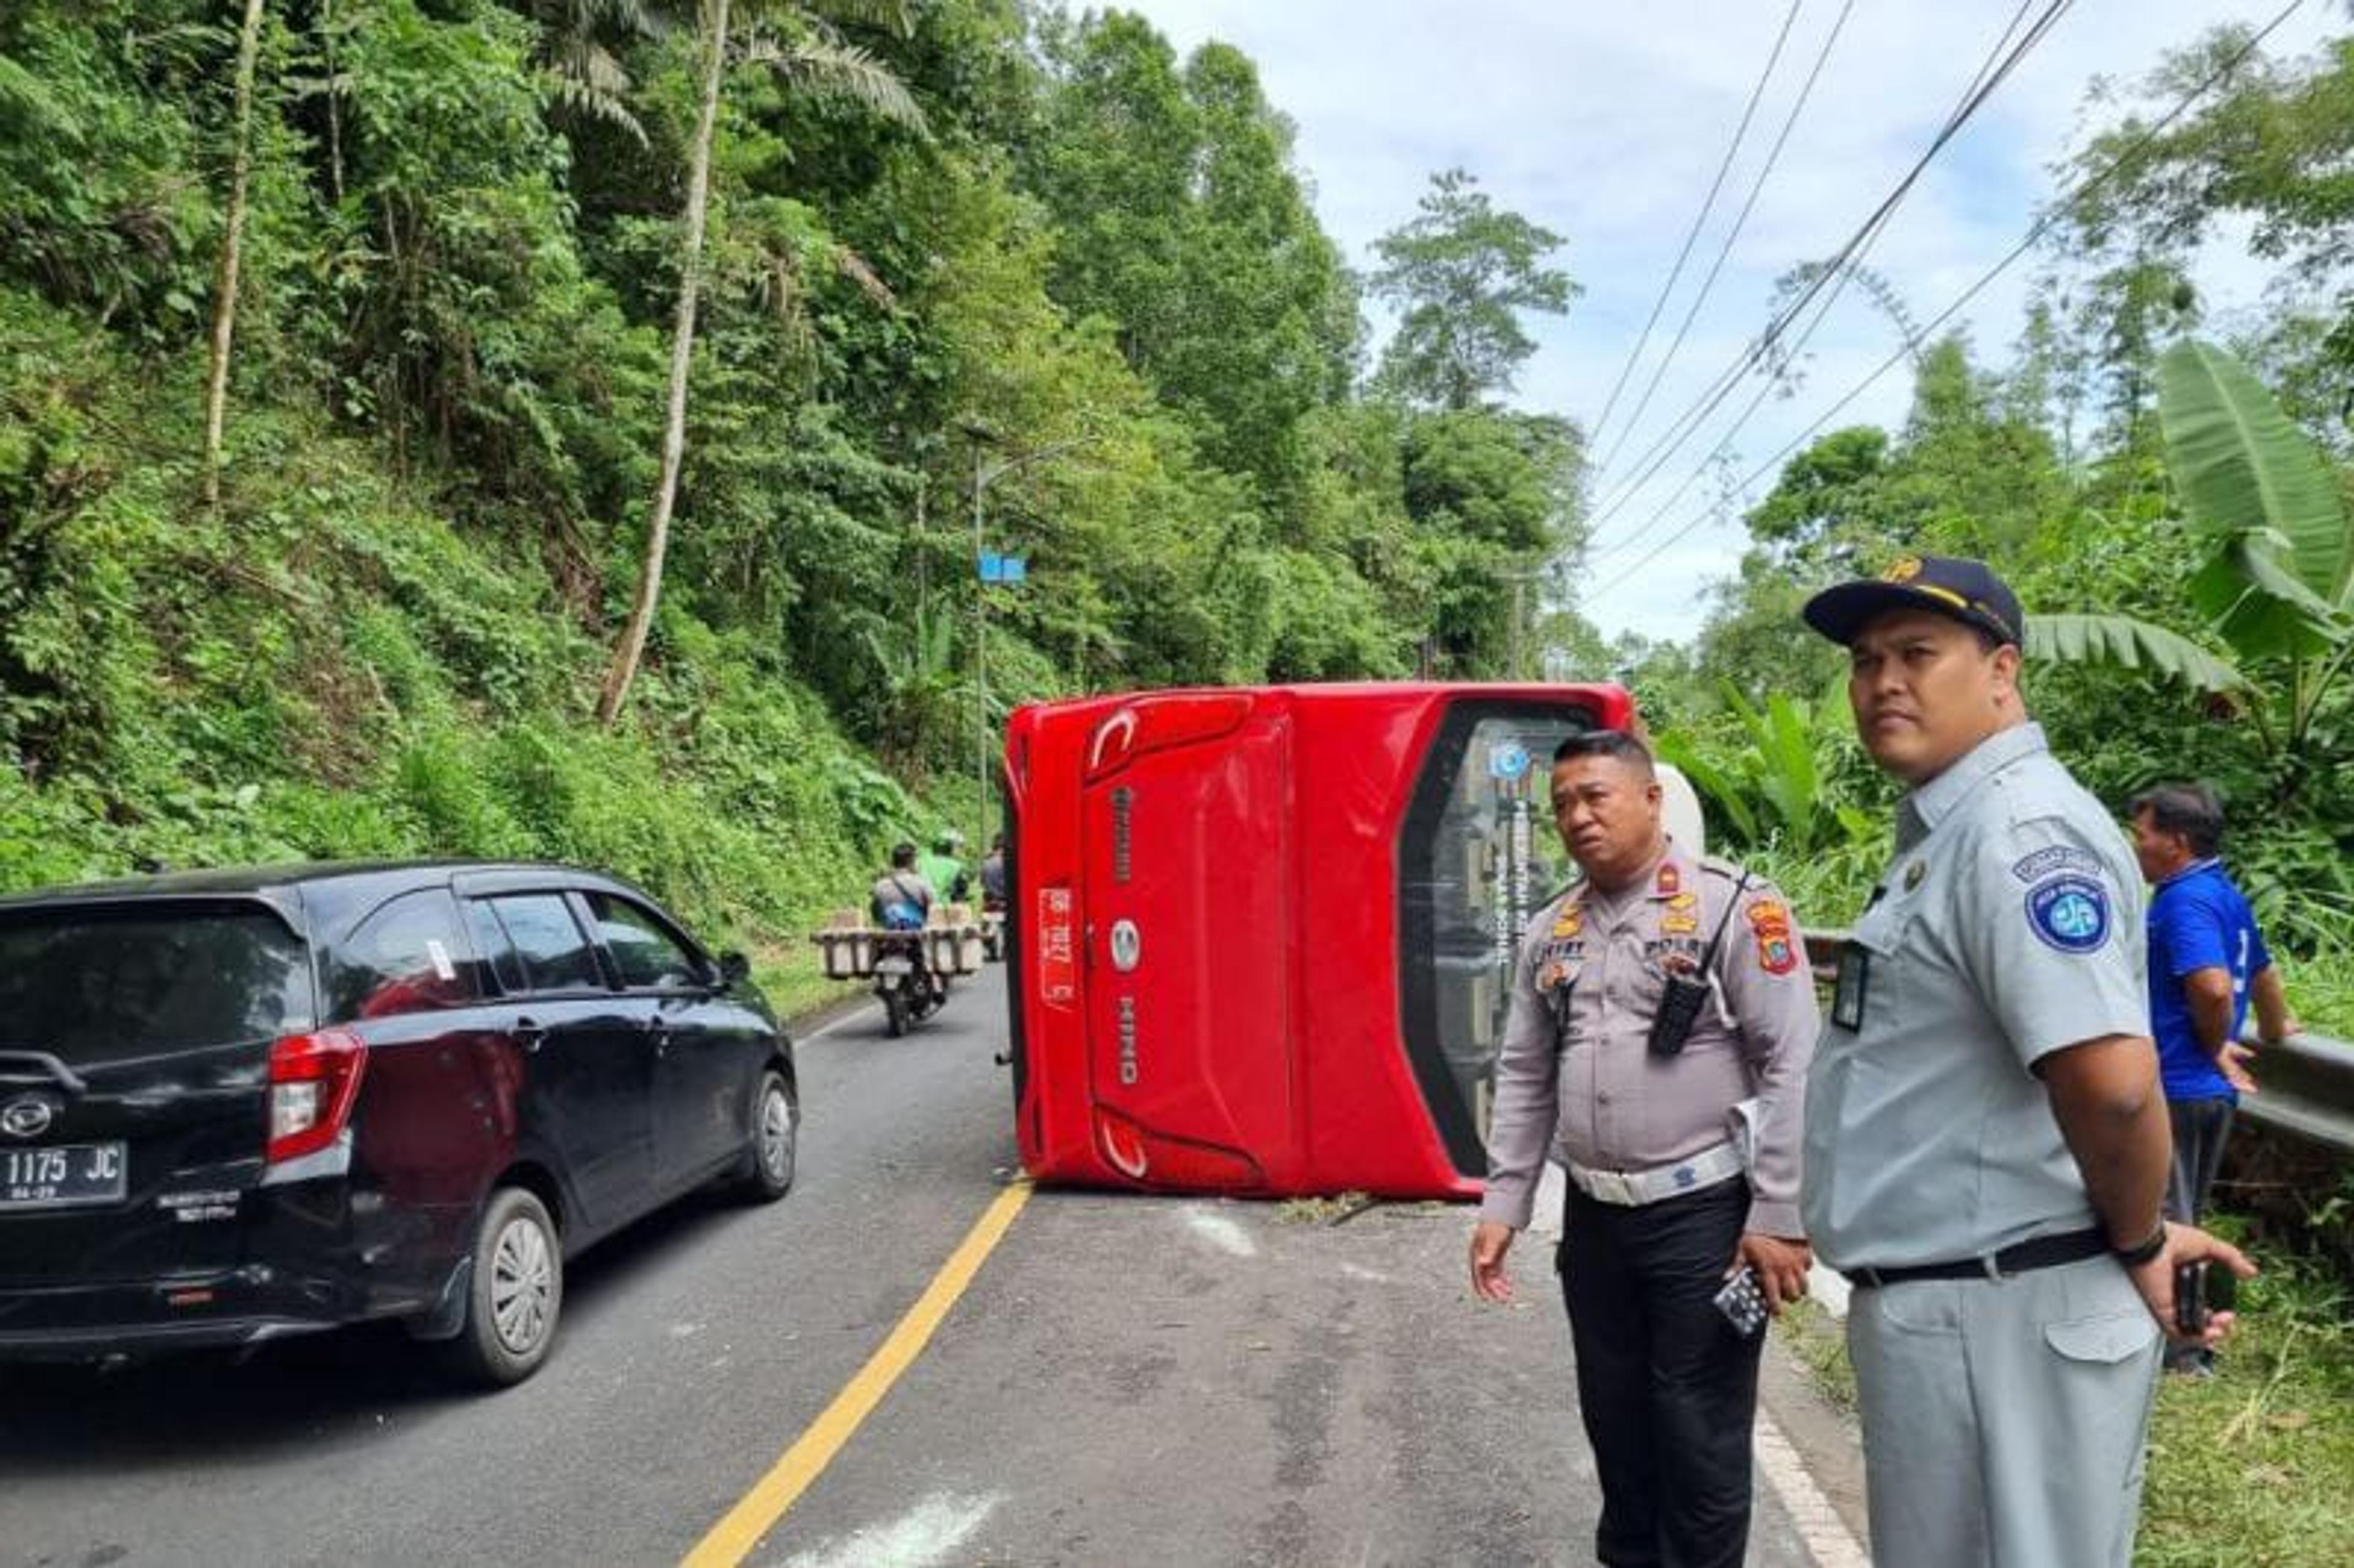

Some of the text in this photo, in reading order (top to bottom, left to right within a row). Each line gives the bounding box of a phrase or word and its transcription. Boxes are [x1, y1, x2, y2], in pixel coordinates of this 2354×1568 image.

[1119, 996, 1137, 1084] HINO
[9, 1147, 118, 1184] 1175 JC
